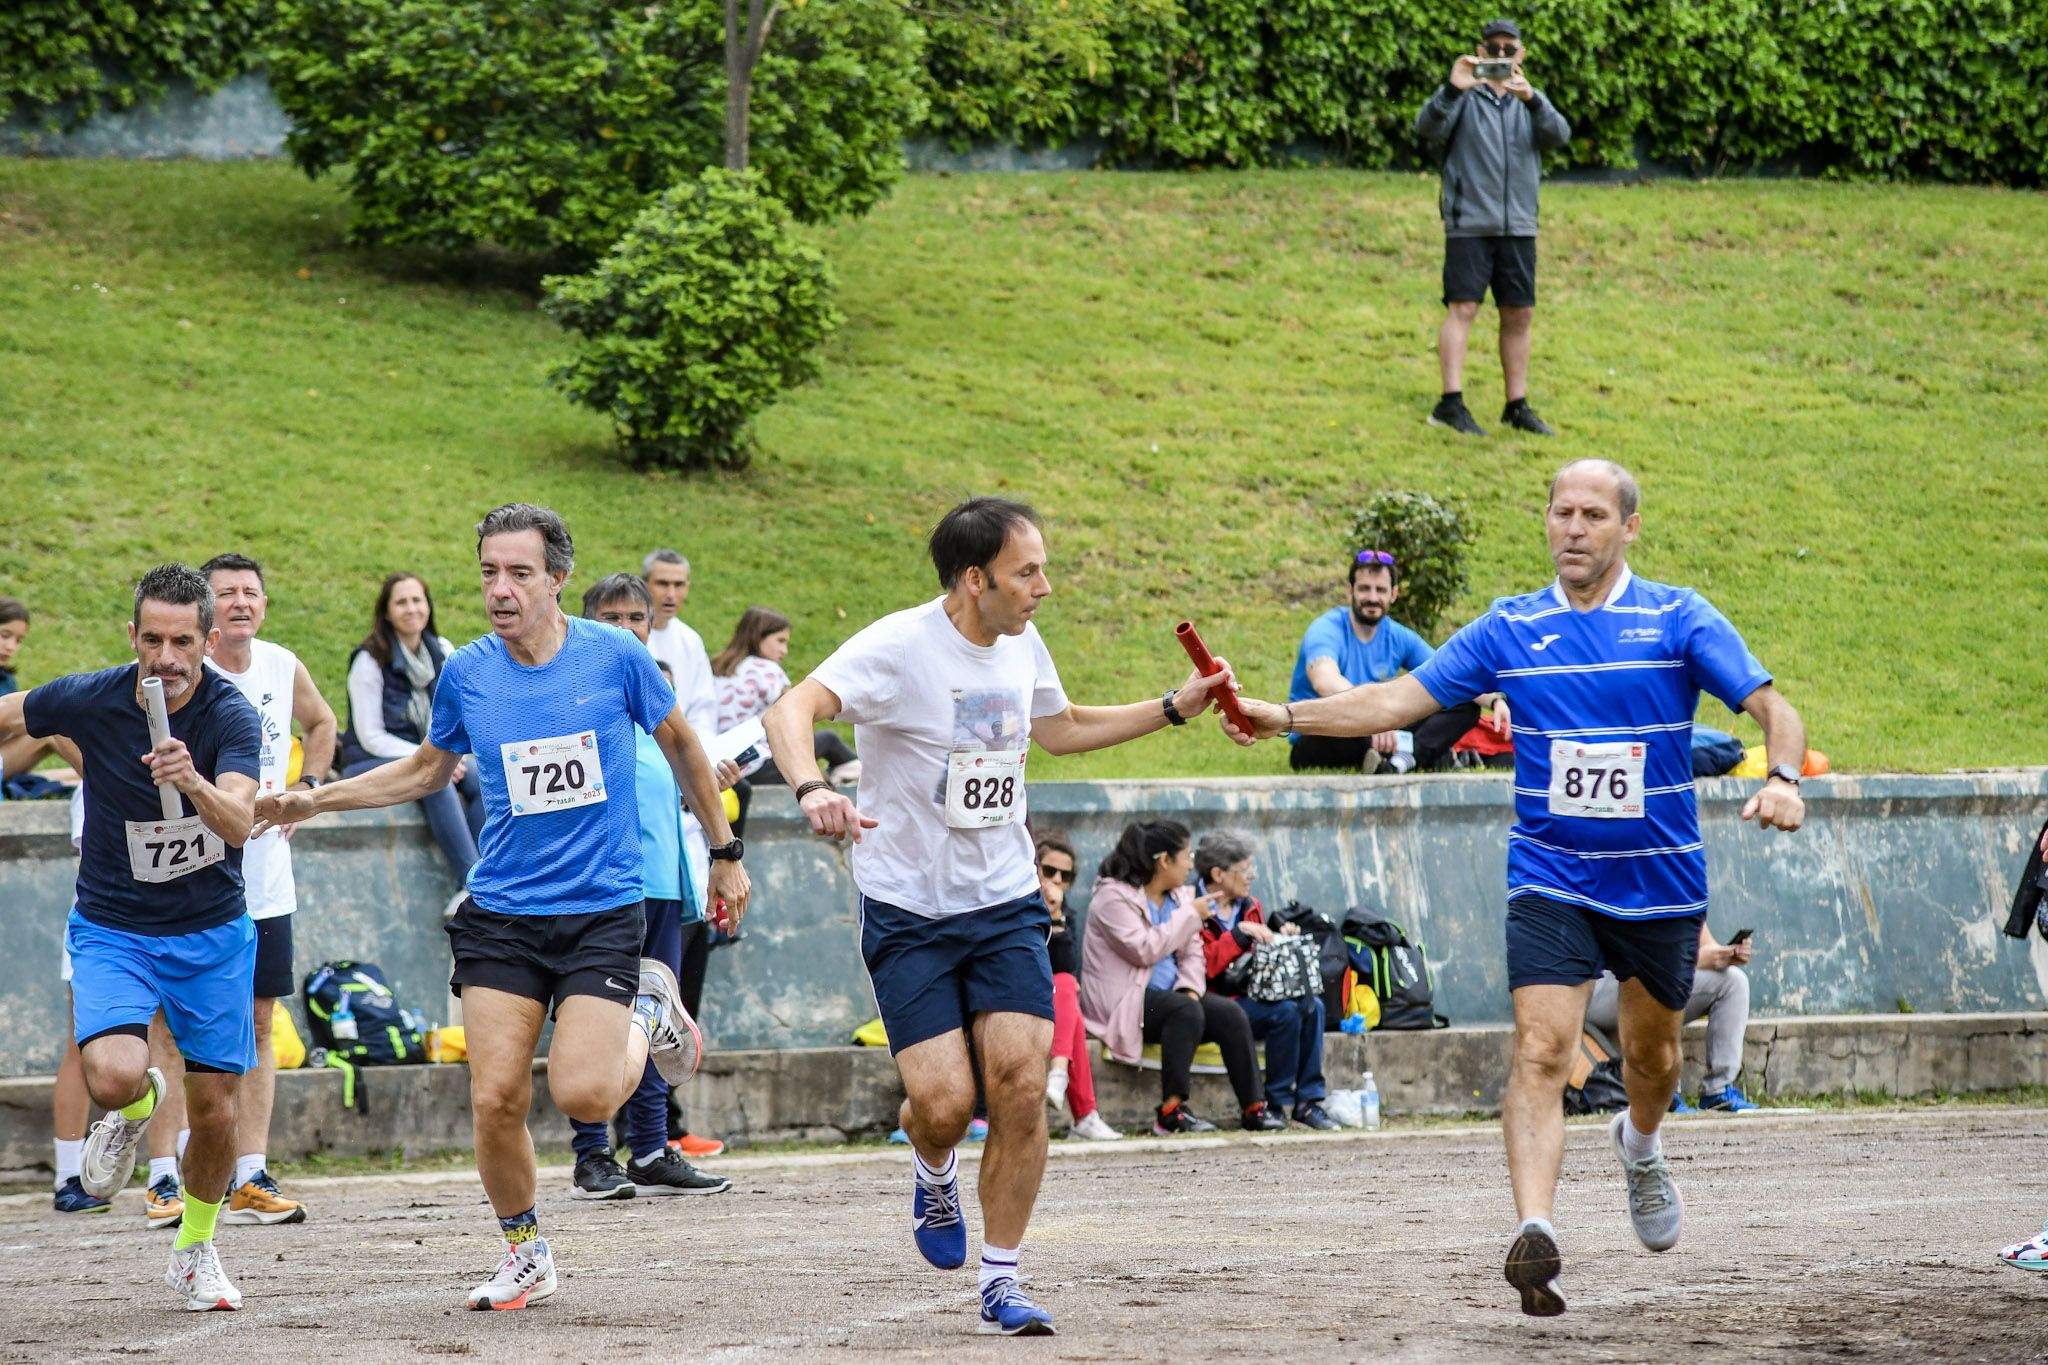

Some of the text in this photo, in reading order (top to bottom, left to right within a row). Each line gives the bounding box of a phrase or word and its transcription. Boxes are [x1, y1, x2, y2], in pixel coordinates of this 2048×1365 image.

[522, 759, 585, 796] 720
[963, 776, 1014, 810] 828
[1565, 767, 1629, 800] 876
[583, 790, 601, 799] 2023
[145, 833, 205, 868] 721
[203, 852, 220, 863] 2023
